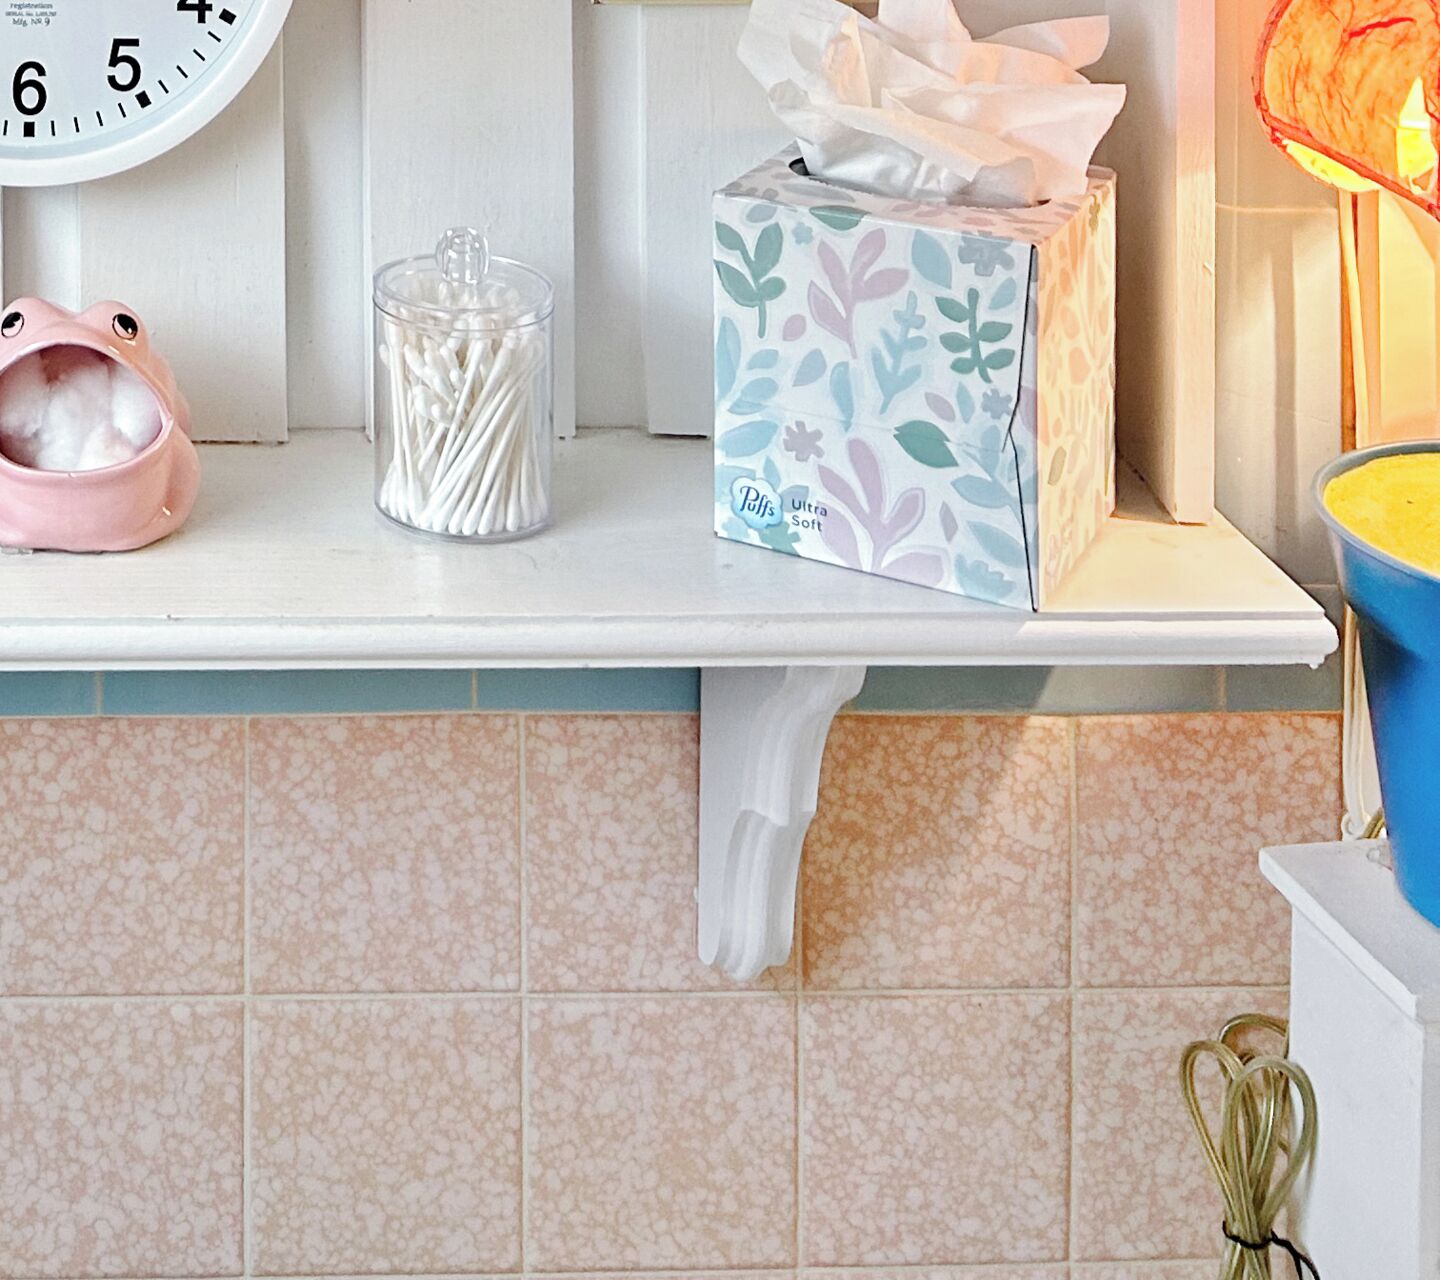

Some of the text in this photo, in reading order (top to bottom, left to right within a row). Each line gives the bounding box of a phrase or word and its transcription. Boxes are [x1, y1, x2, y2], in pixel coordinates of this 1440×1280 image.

[106, 37, 143, 93] 5
[12, 61, 47, 116] 6
[739, 485, 776, 518] Puffs
[791, 498, 828, 517] Ultra
[791, 514, 823, 532] Soft
